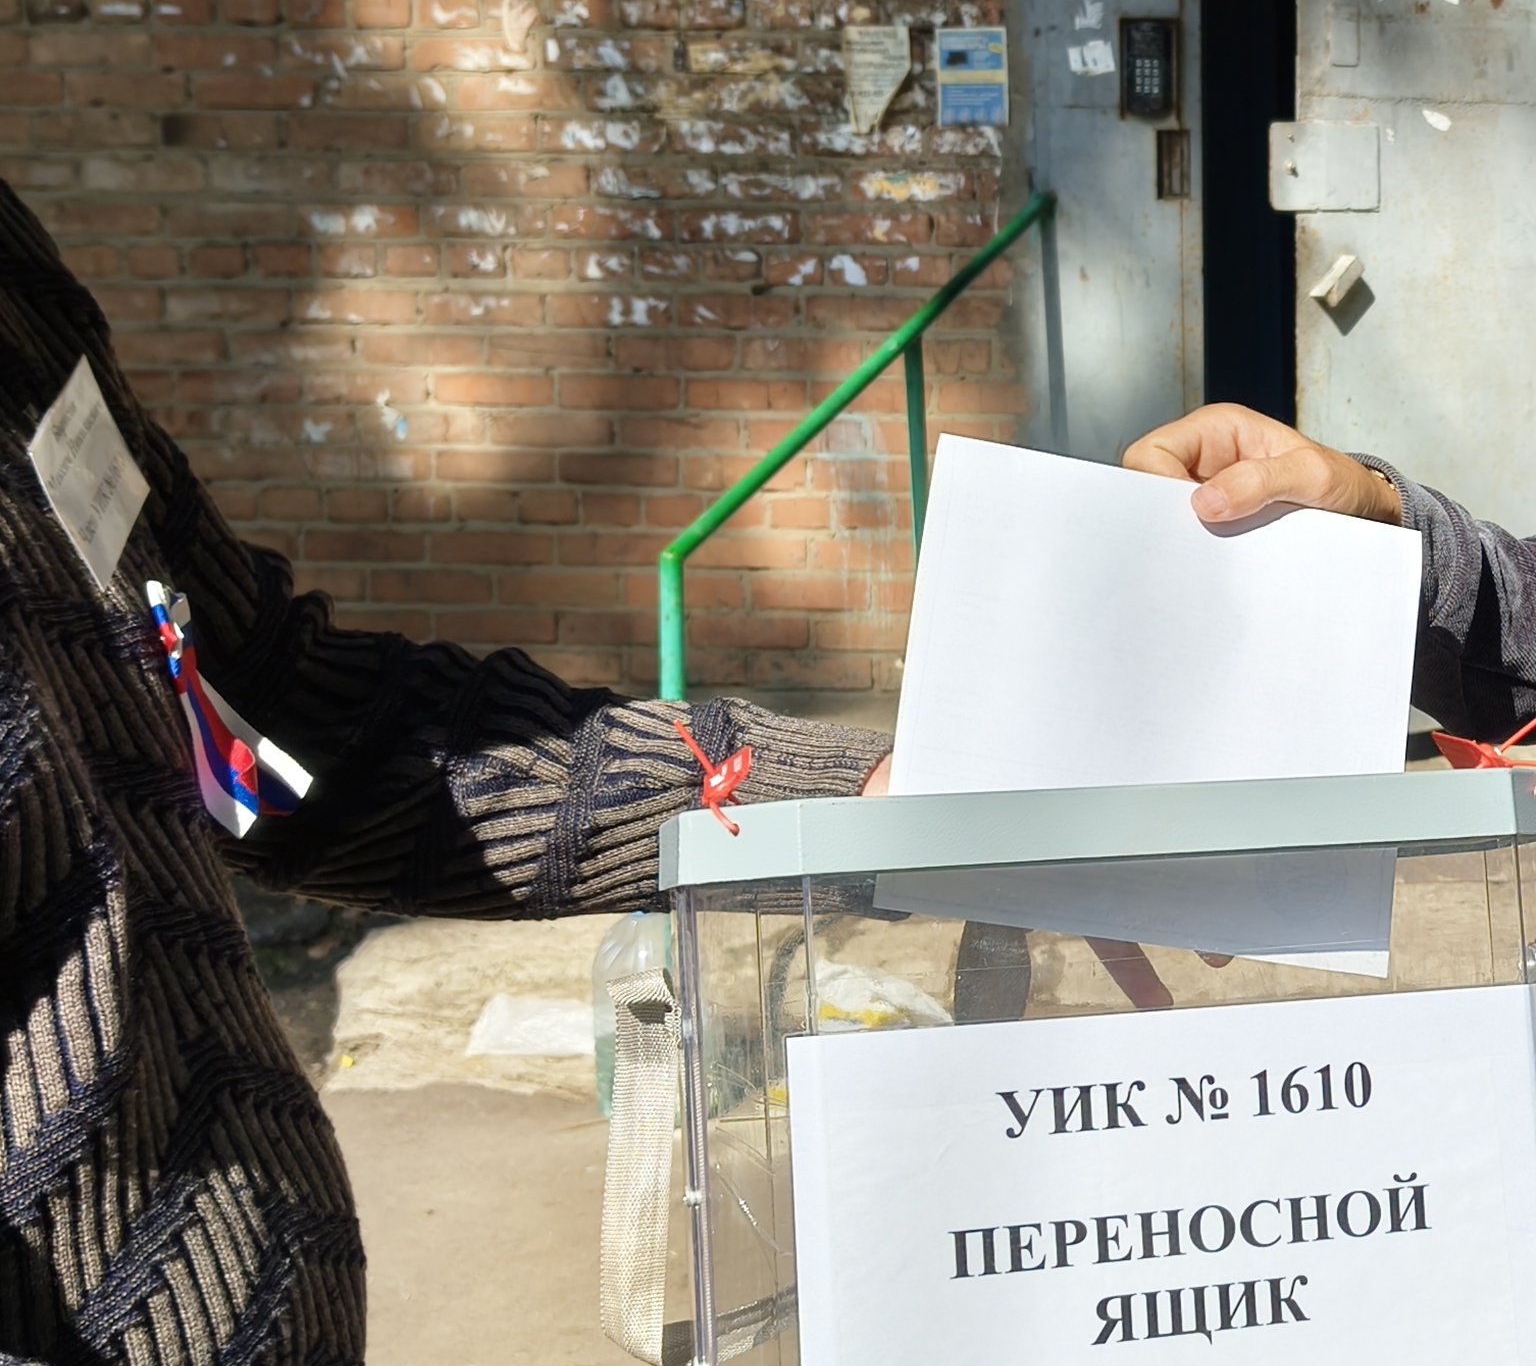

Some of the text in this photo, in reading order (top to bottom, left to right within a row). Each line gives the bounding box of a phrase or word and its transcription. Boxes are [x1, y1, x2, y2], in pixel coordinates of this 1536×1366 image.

[997, 1061, 1372, 1139] УИК № 1610
[950, 1172, 1430, 1279] ПЕРЕНОСНОЙ
[1092, 1275, 1311, 1346] ЯЩИК
